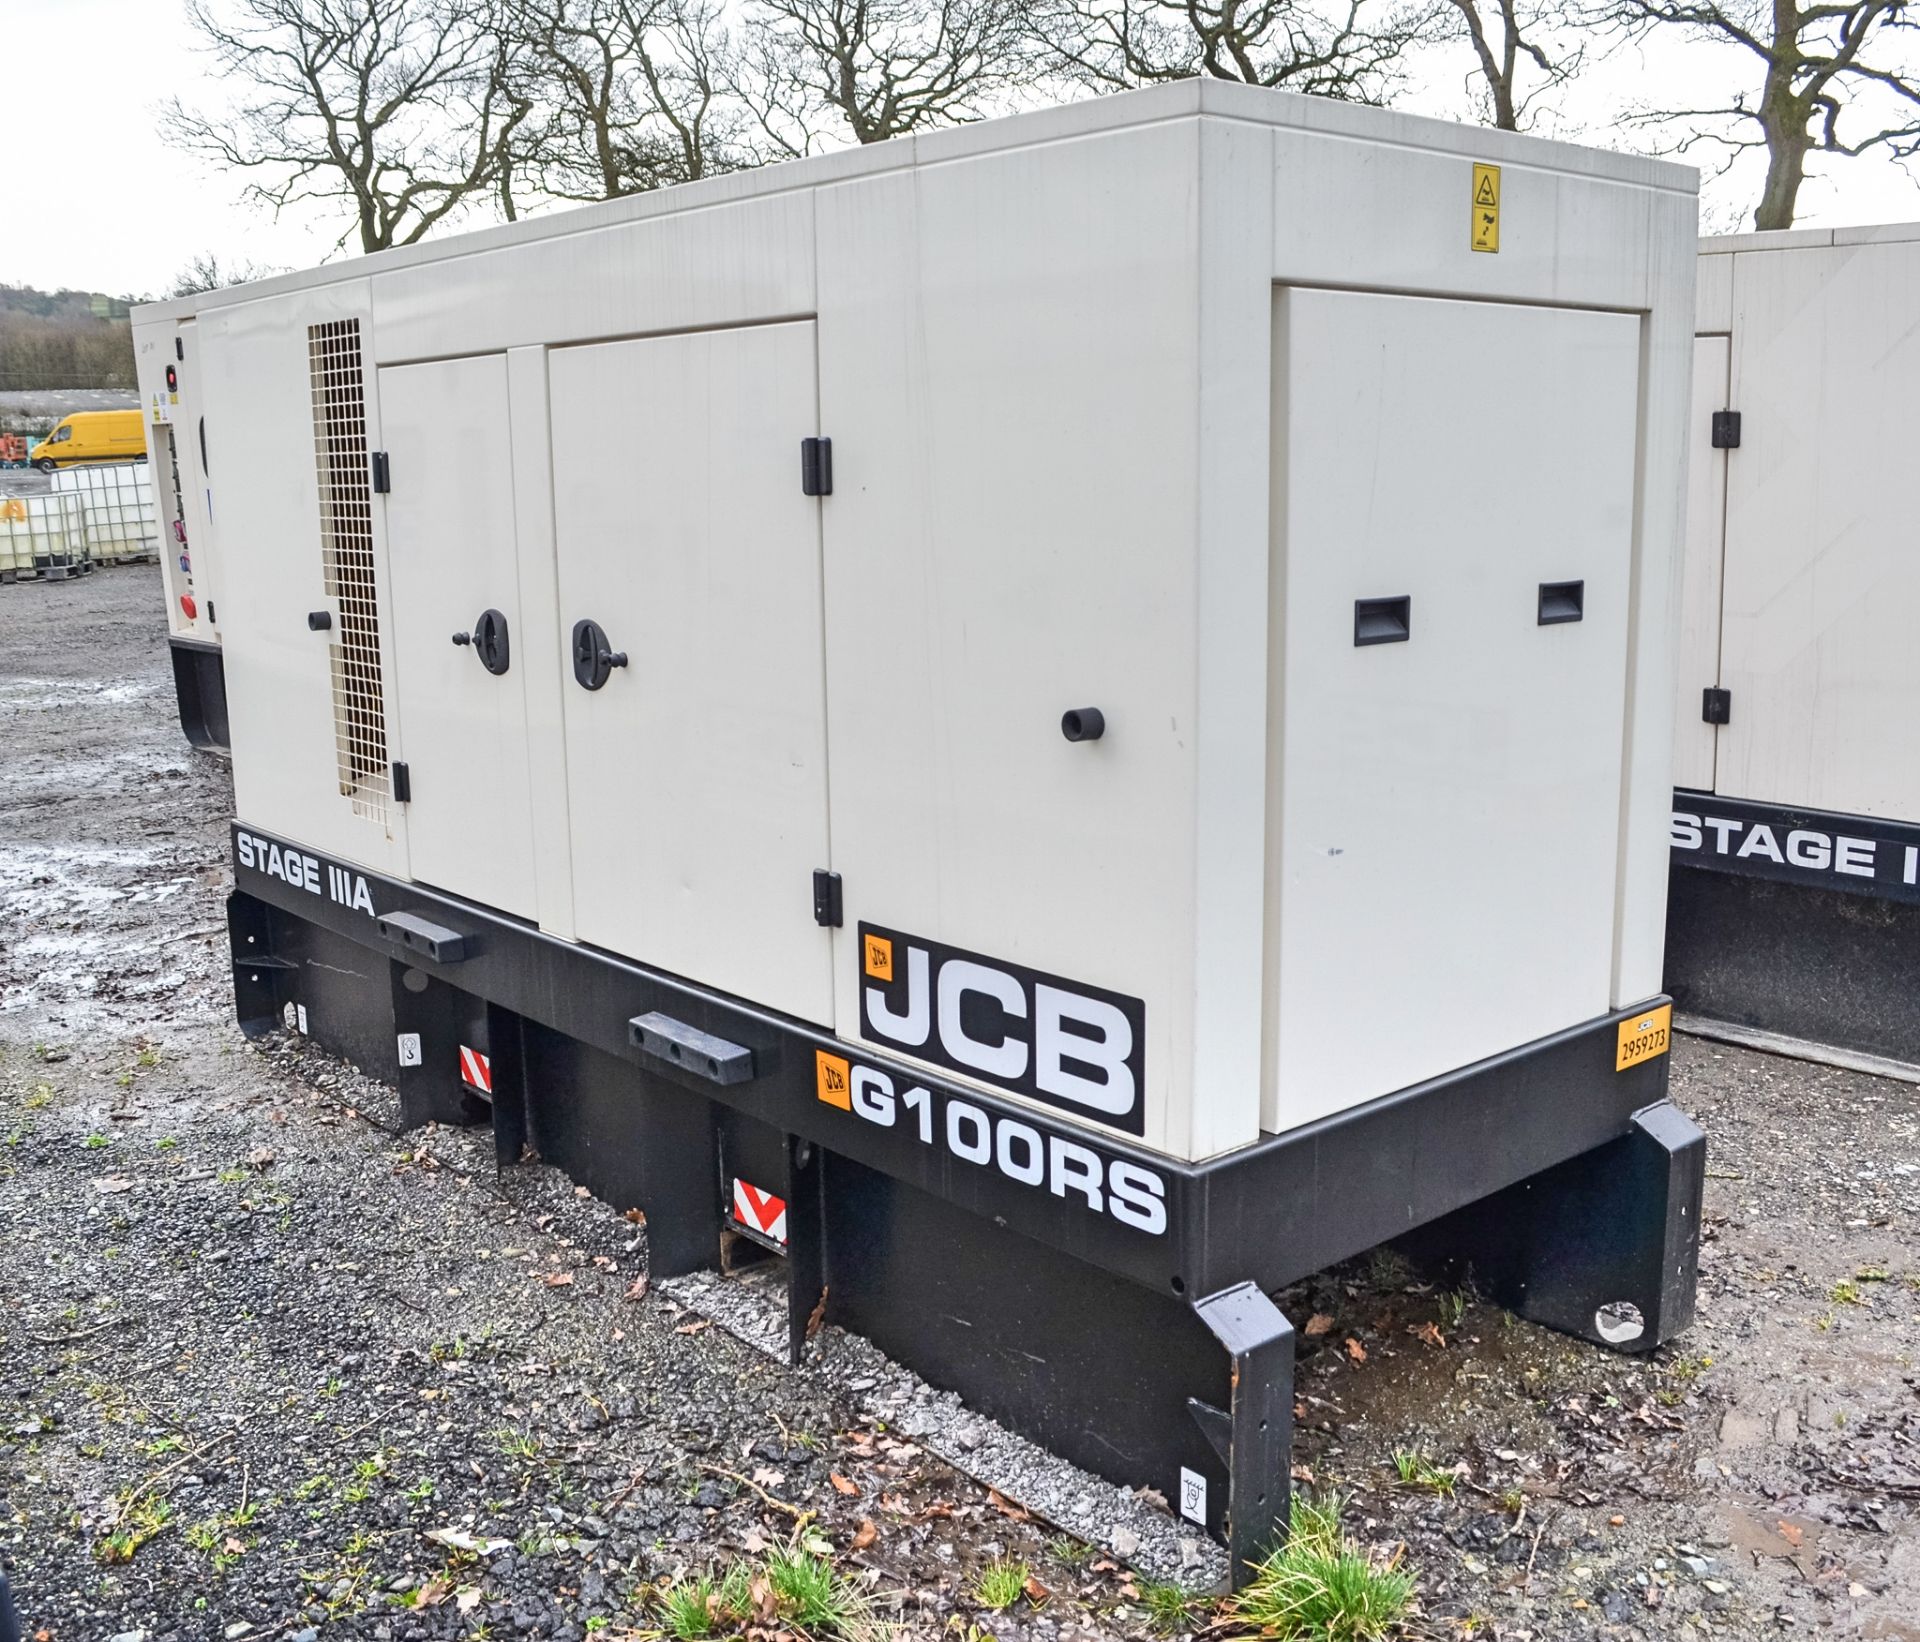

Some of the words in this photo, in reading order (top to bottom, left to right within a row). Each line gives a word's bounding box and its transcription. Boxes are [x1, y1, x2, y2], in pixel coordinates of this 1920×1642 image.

[237, 832, 321, 894] STAGE
[328, 866, 375, 916] IIIA
[1671, 812, 1876, 877] STAGE
[870, 945, 888, 967] JCB
[866, 946, 1135, 1115] JCB
[1622, 1028, 1666, 1061] 2959273
[824, 1065, 845, 1091] JCB
[850, 1065, 1166, 1235] G100RS
